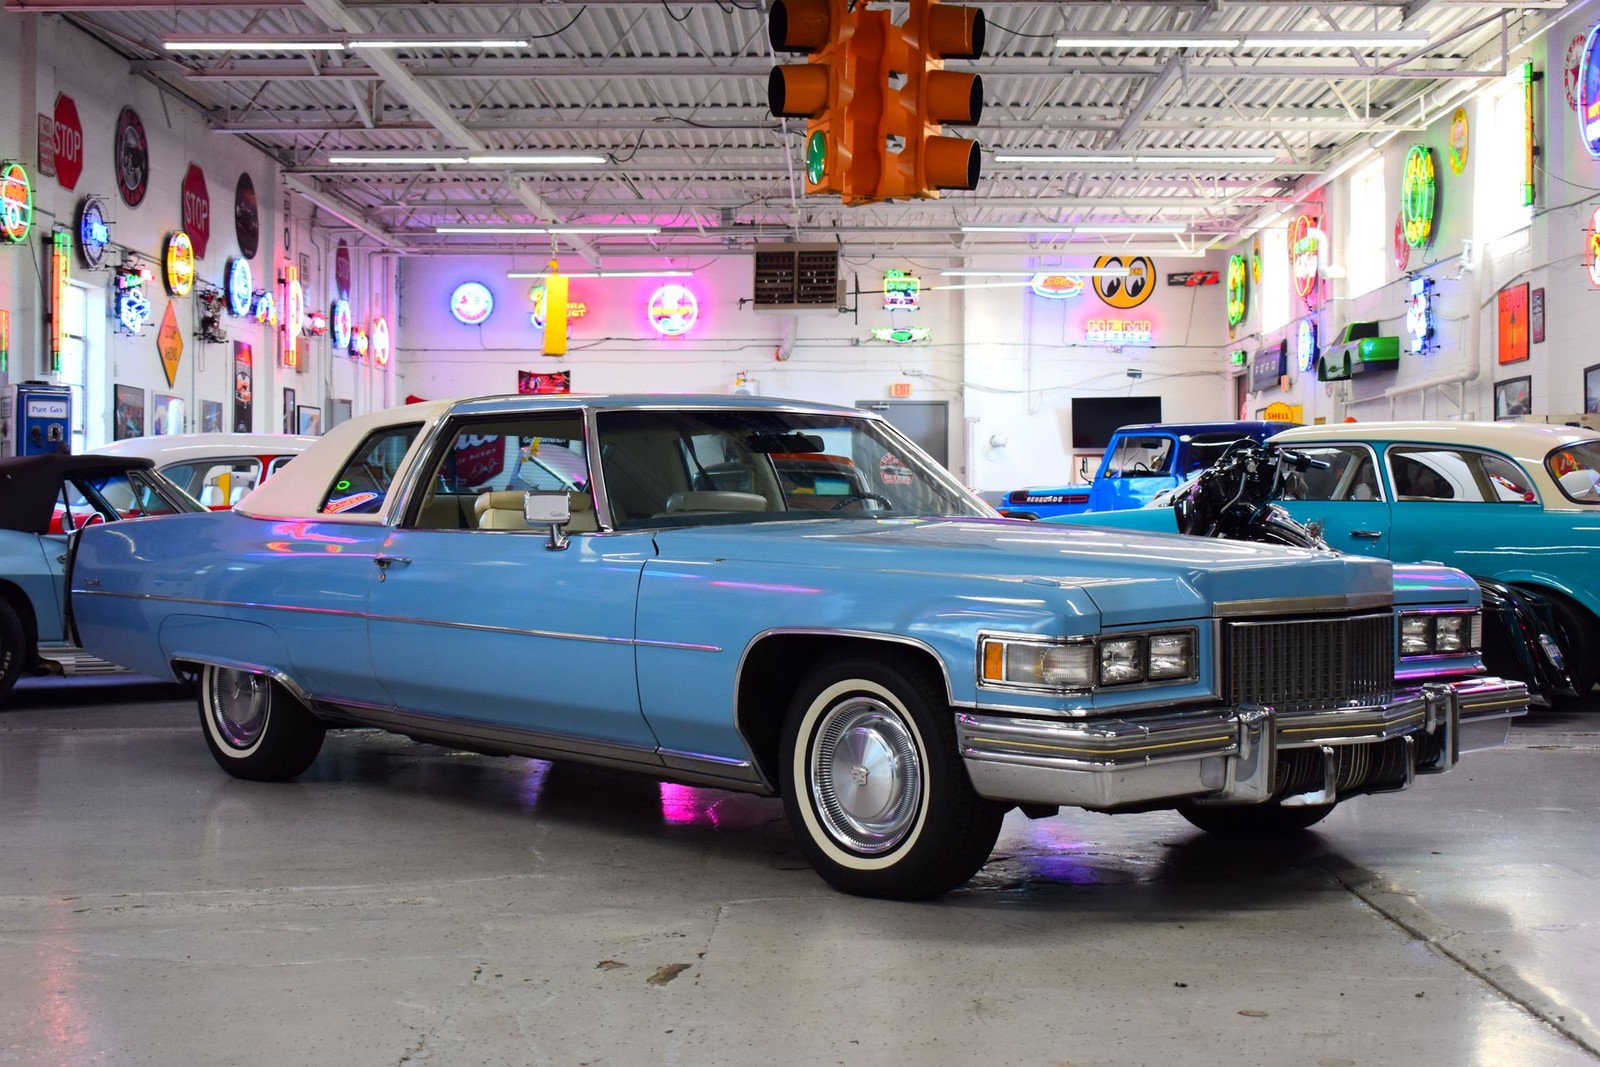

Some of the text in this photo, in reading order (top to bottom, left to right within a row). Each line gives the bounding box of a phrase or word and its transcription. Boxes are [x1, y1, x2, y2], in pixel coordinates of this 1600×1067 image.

[54, 121, 81, 163] STOP
[185, 190, 208, 232] STOP
[1087, 320, 1151, 332] HEMI
[1026, 495, 1064, 503] RENEGADE
